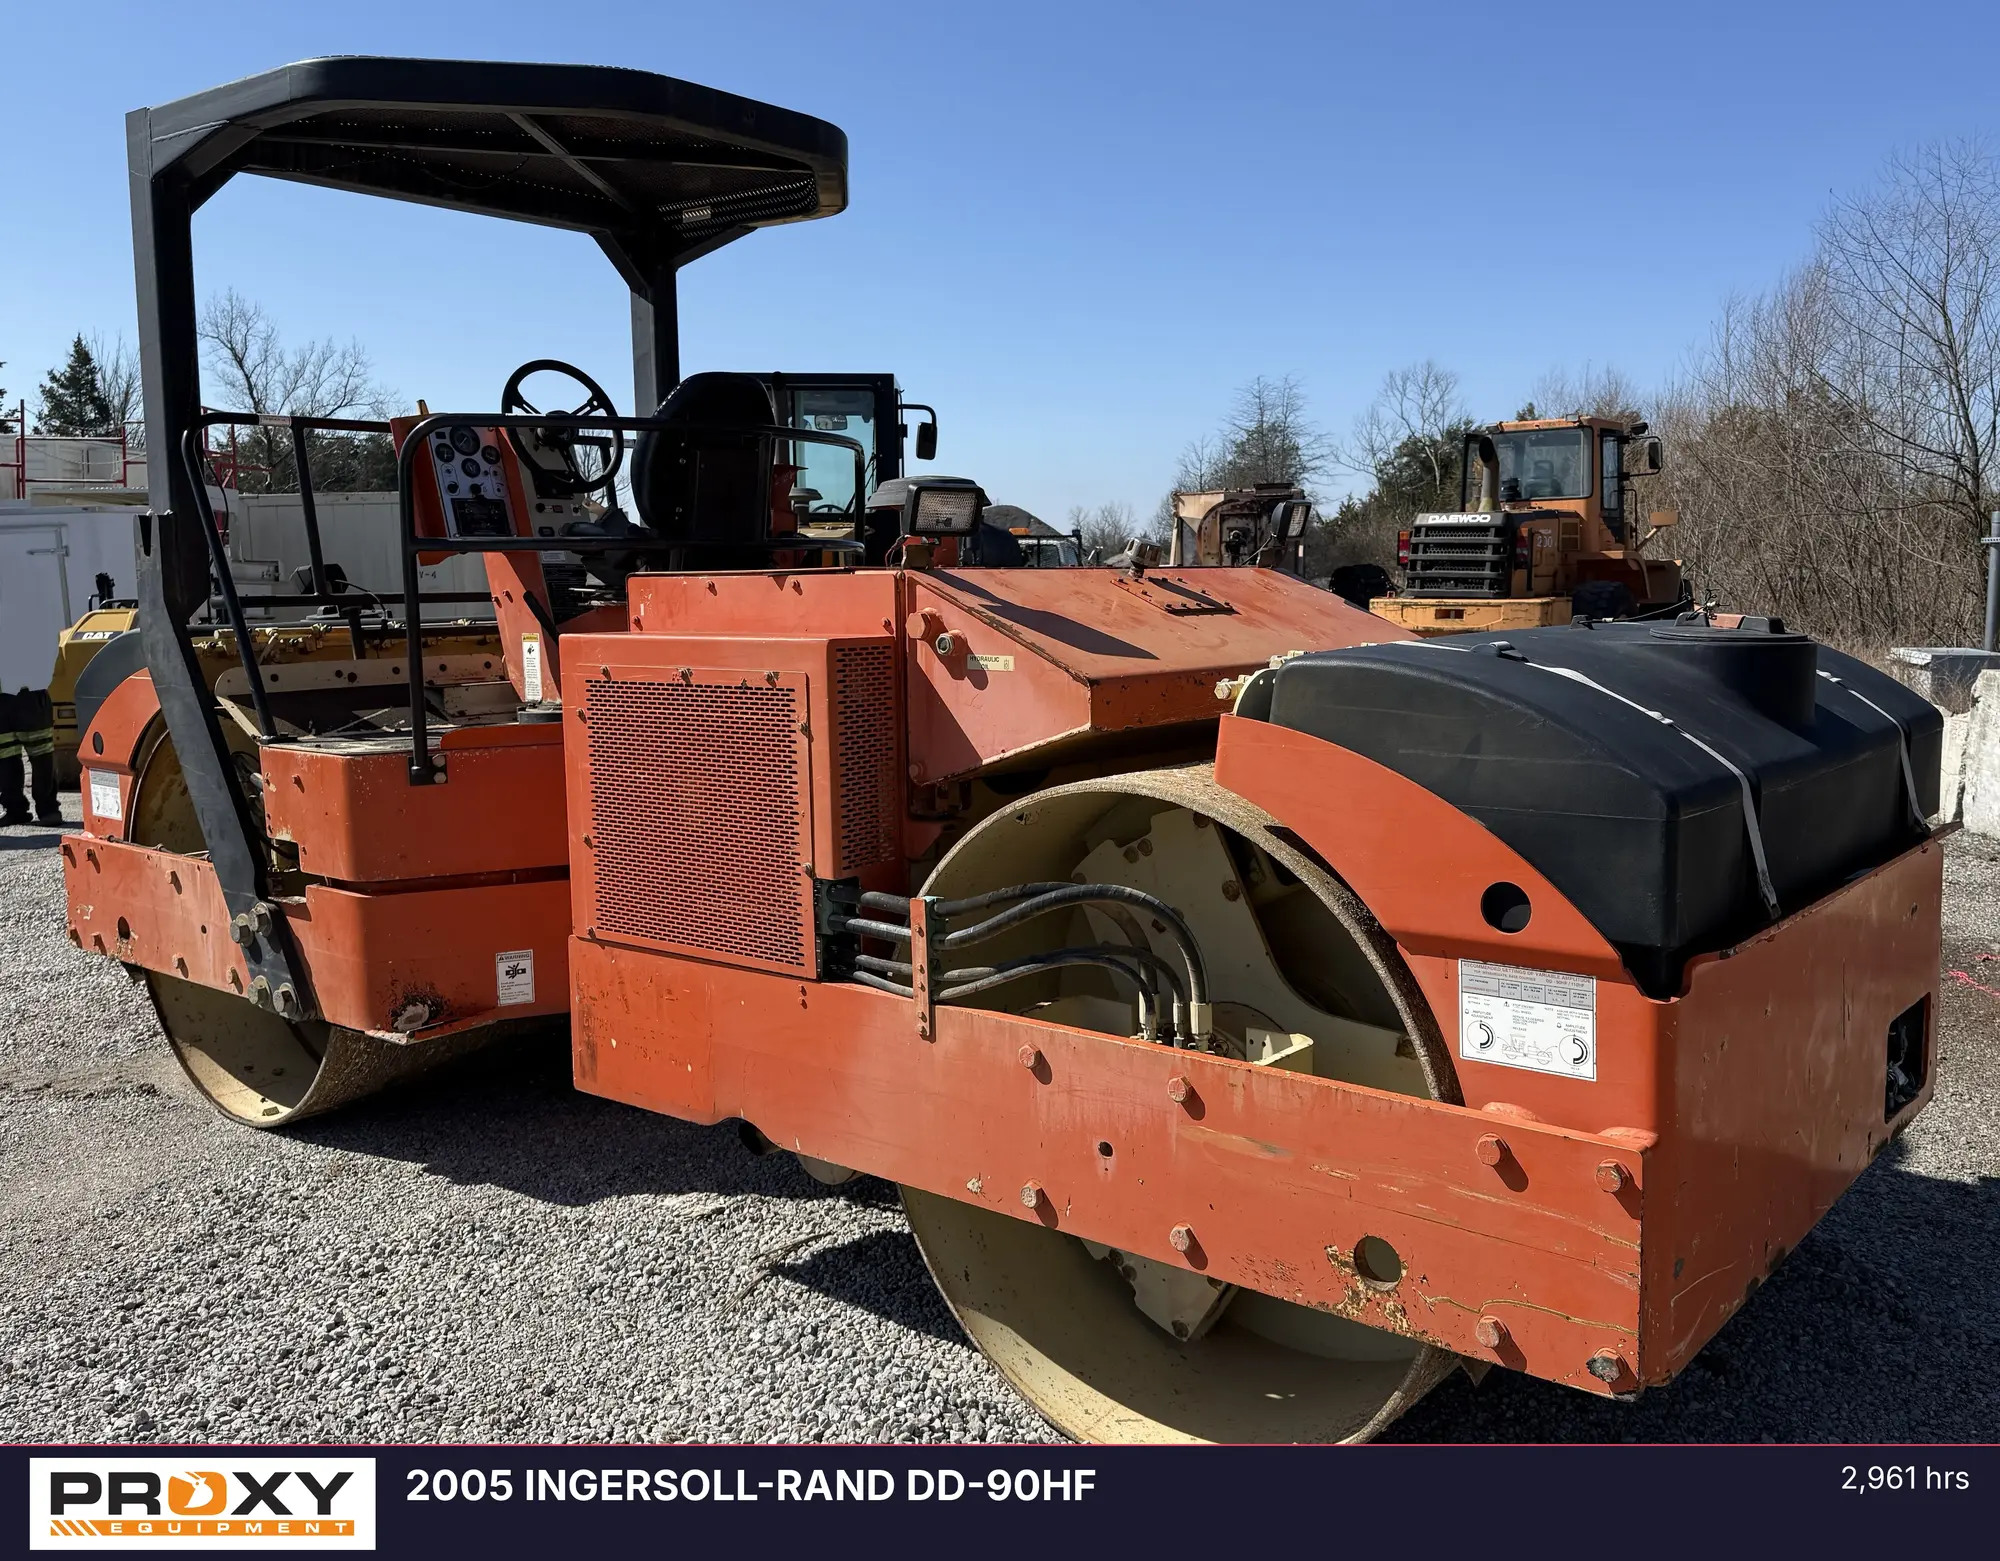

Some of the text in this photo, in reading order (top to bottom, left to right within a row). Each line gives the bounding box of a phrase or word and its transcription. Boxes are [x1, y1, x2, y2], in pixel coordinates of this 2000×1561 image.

[1428, 514, 1491, 524] DAEWOO
[81, 631, 114, 640] CAT
[969, 655, 1000, 663] HYDRAULIC
